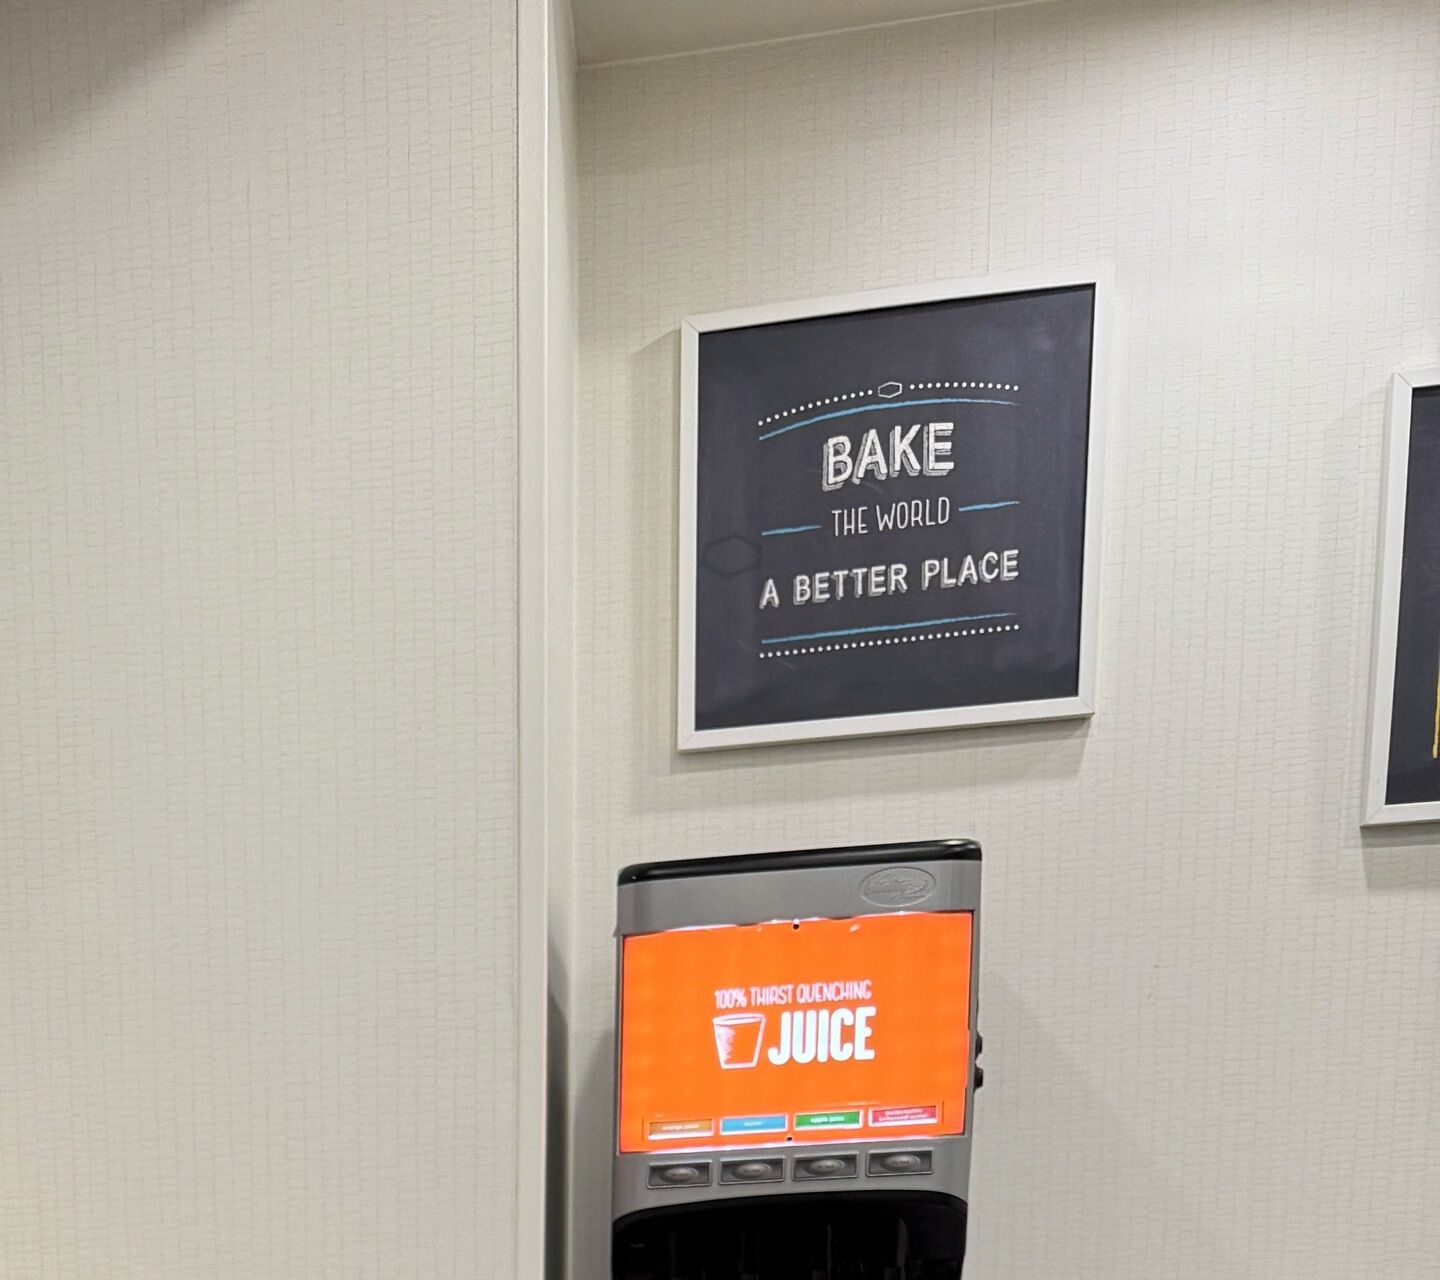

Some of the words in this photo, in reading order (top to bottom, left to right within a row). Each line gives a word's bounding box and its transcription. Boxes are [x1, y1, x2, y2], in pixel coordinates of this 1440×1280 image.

[822, 422, 956, 491] BAKE
[831, 506, 868, 536] THE
[876, 497, 950, 531] WORLD
[759, 578, 780, 609] A
[793, 563, 908, 605] BETTER
[921, 549, 1019, 590] PLACE
[714, 987, 747, 1009] 100%
[750, 983, 795, 1006] THIRST
[796, 979, 873, 1004] QUENCHING
[767, 1006, 877, 1065] JUICE
